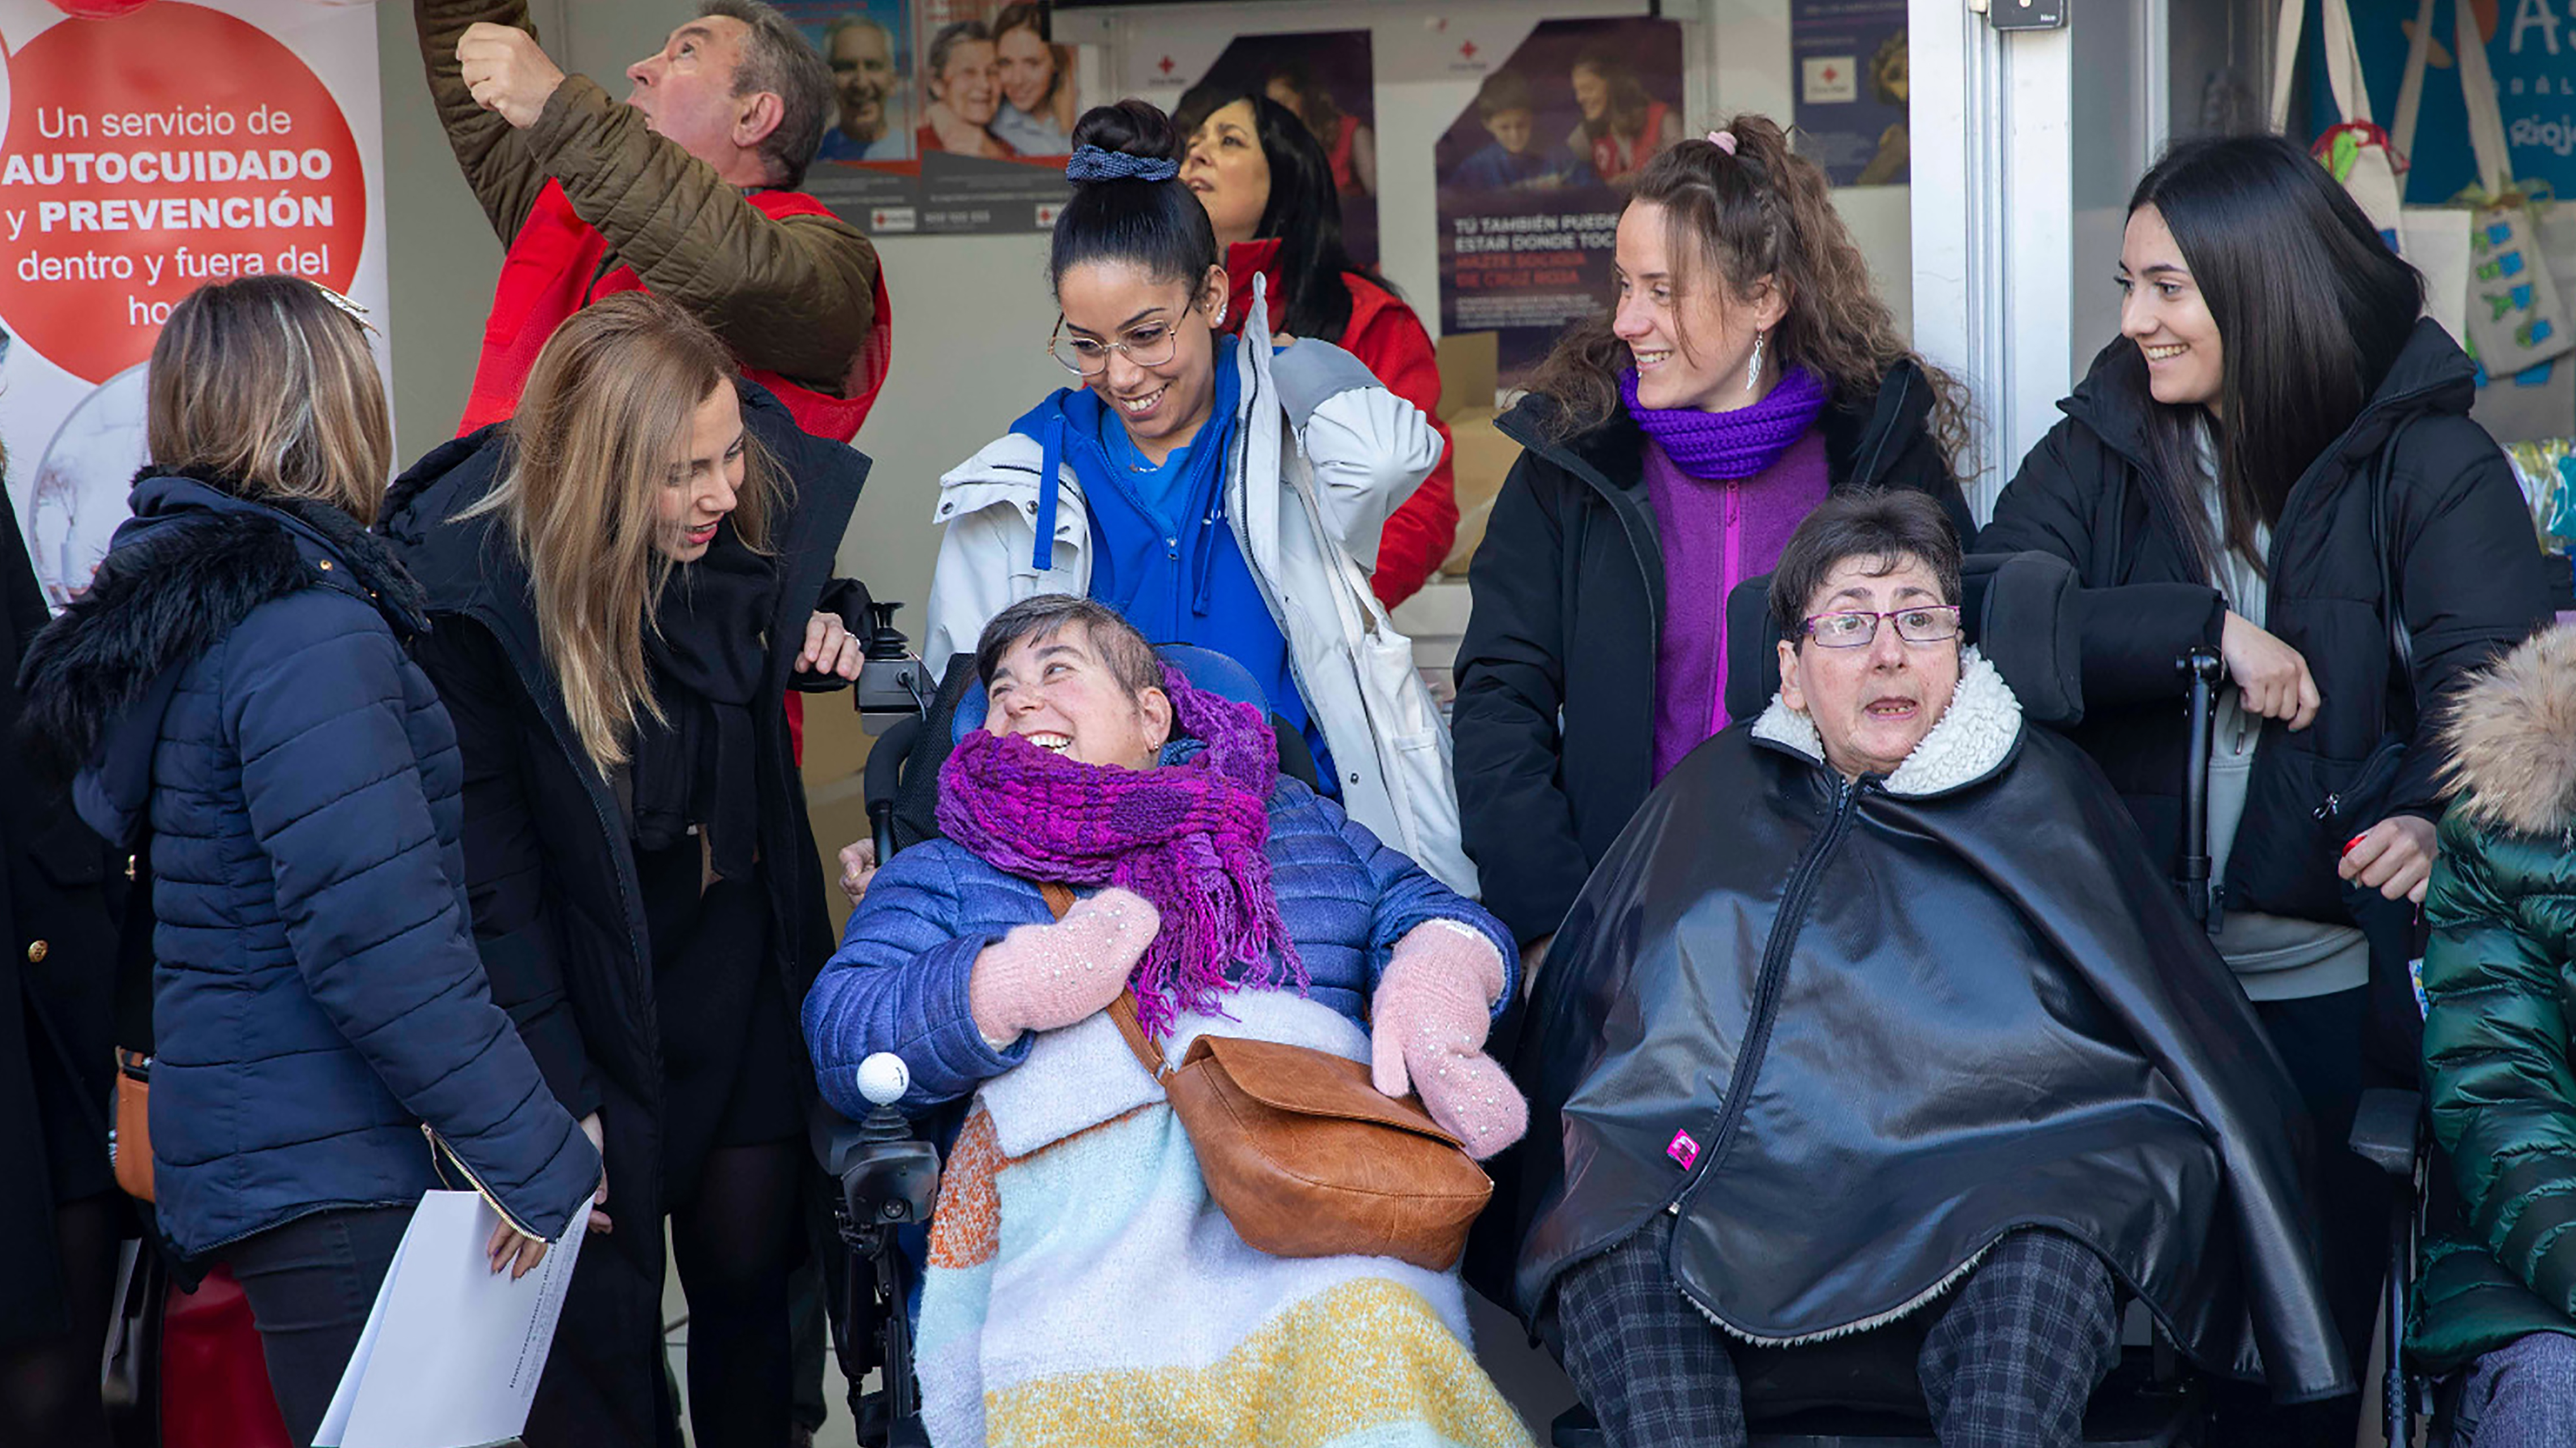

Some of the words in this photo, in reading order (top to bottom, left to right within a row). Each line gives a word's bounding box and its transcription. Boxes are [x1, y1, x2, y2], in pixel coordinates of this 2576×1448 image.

[37, 106, 88, 138] Un
[101, 104, 236, 137] servicio
[247, 103, 292, 135] de
[2510, 114, 2576, 156] Rioj
[1, 148, 332, 186] AUTOCUIDADO
[5, 209, 26, 241] y
[38, 189, 334, 233] PREVENCIÓN
[1454, 216, 1478, 234] TÚ
[1481, 214, 1557, 233] TAMBIÉN
[1561, 215, 1618, 230] PUEDE
[1455, 236, 1509, 252] ESTAR
[1512, 234, 1575, 250] DONDE
[1579, 232, 1615, 249] TOC
[16, 250, 134, 283] dentro
[144, 254, 164, 286] y
[174, 245, 264, 277] fuera
[276, 243, 329, 275] del
[127, 294, 178, 326] ho
